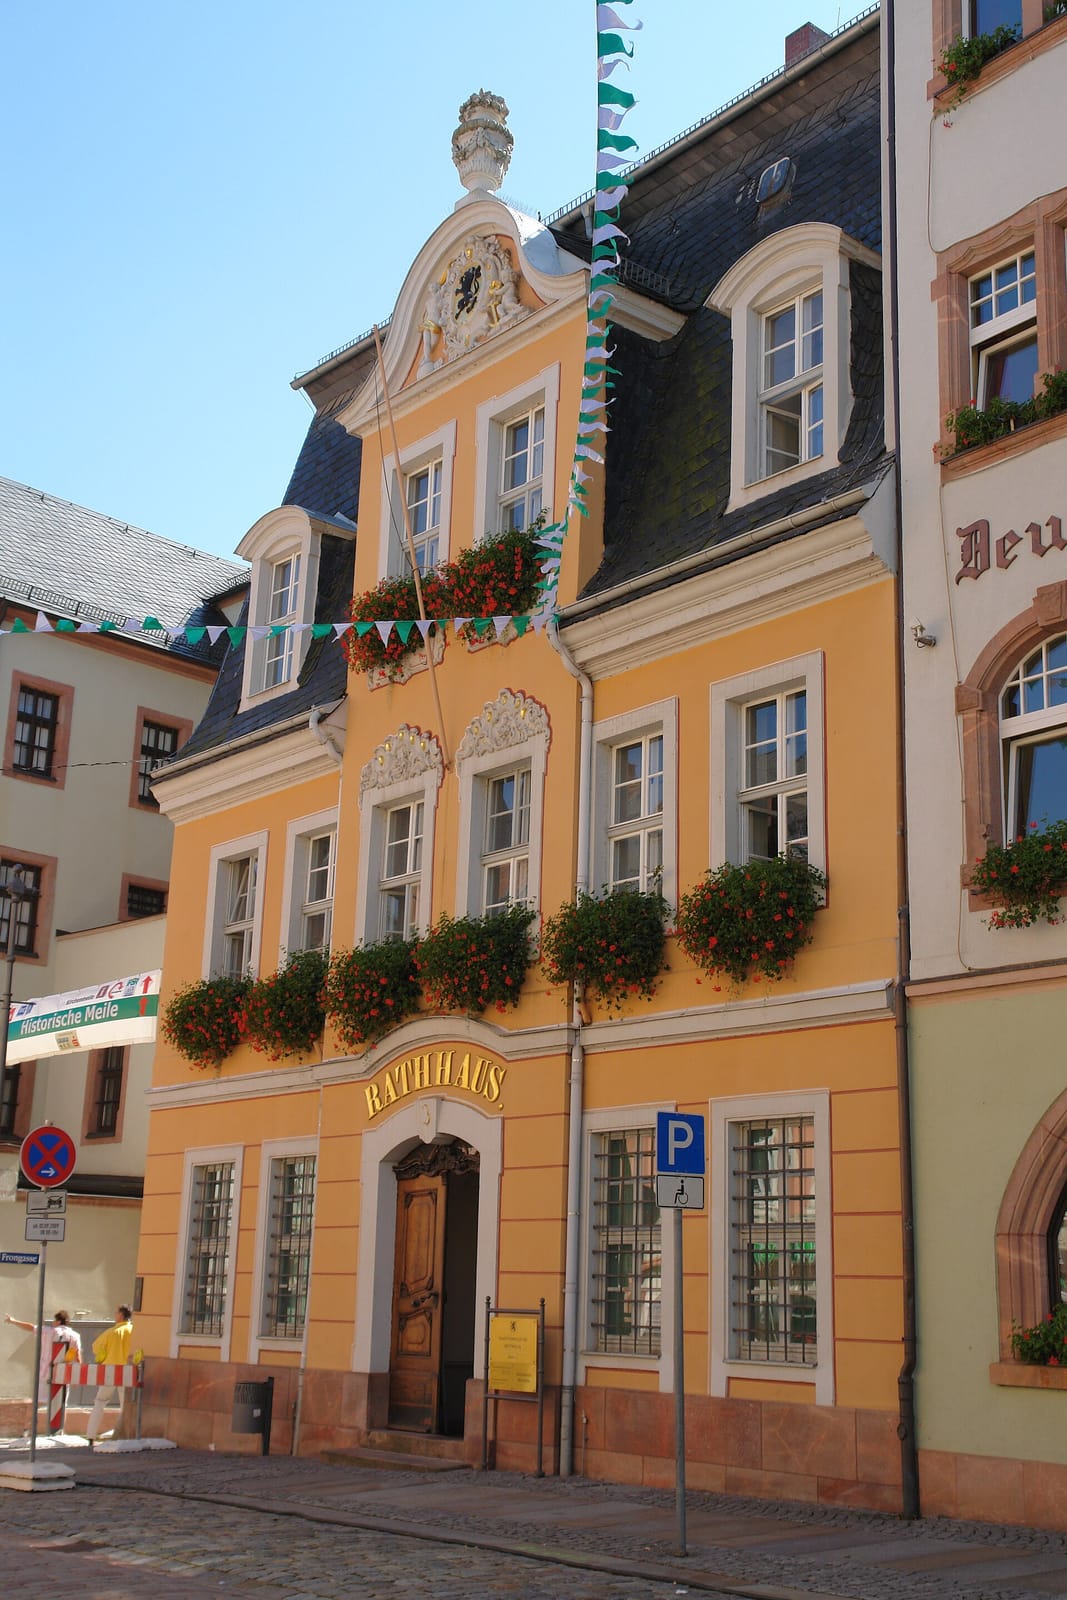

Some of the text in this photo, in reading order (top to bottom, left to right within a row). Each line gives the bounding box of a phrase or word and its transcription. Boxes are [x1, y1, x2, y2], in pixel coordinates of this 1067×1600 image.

[20, 1009, 81, 1035] Historische
[85, 1001, 118, 1022] Meile
[668, 1119, 694, 1166] P
[1, 1253, 38, 1264] Frongasse
